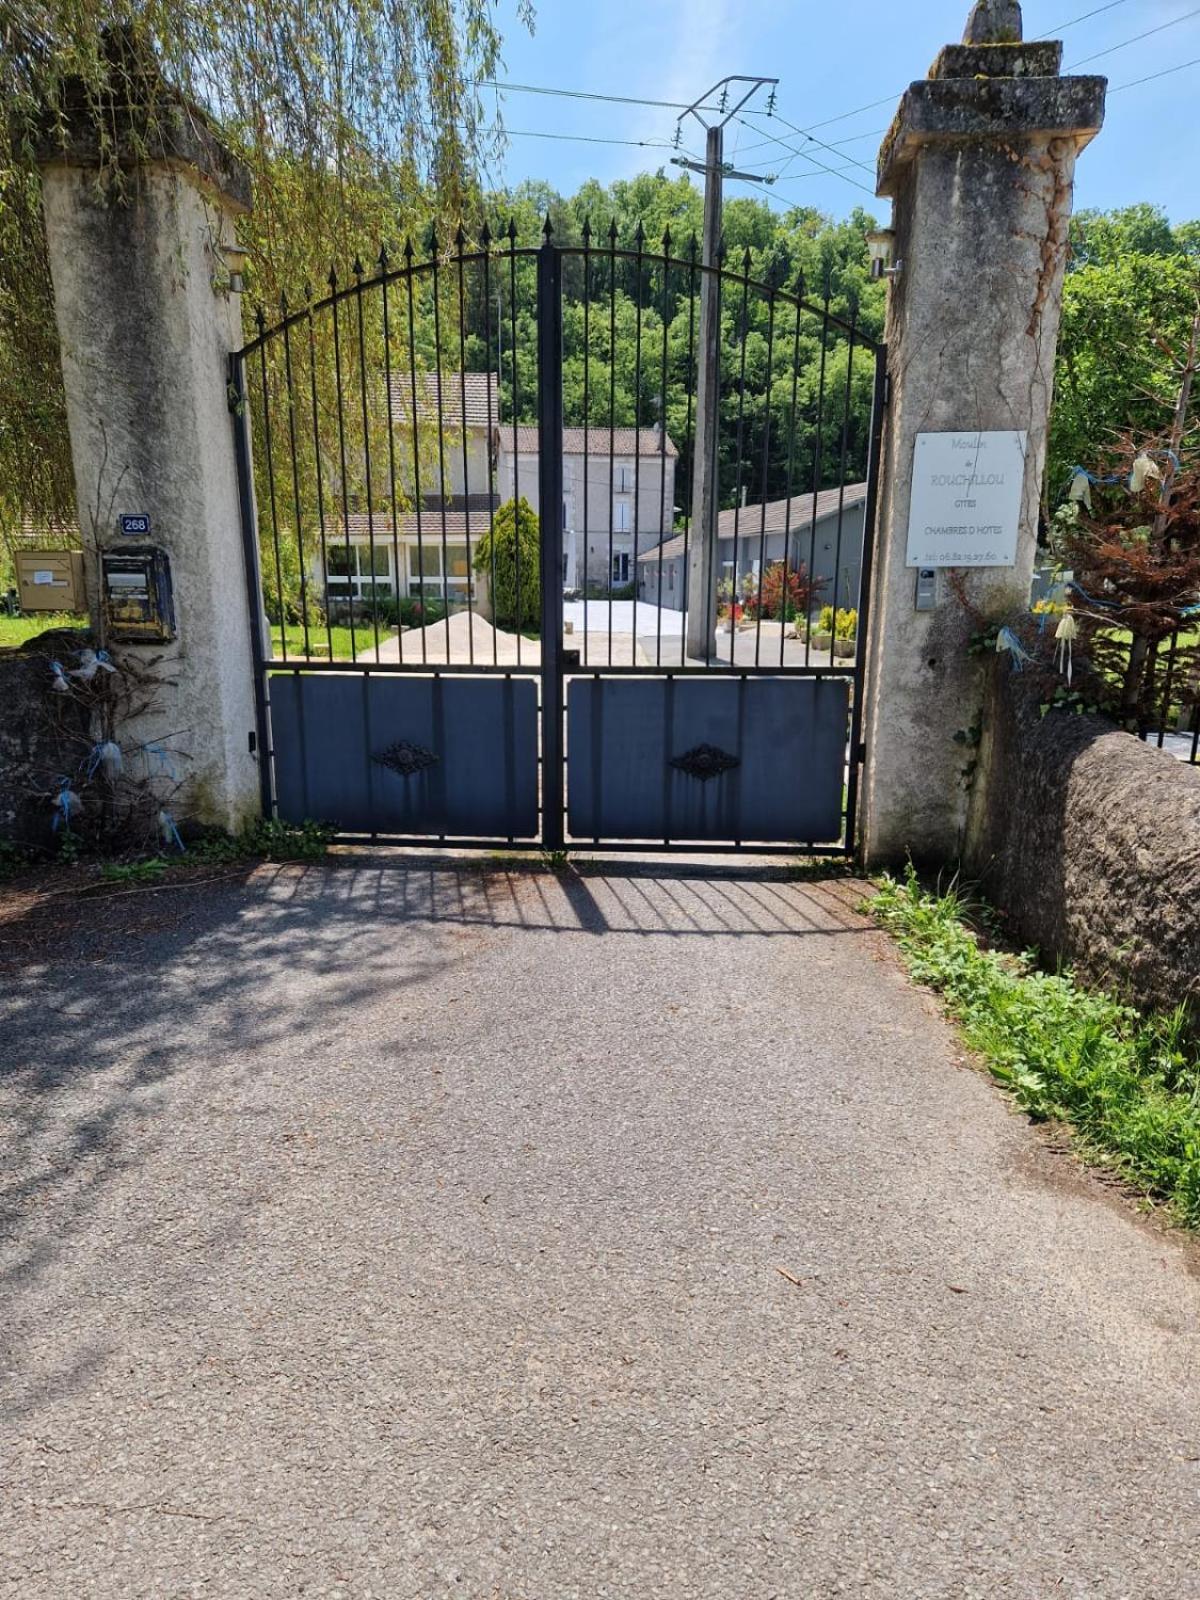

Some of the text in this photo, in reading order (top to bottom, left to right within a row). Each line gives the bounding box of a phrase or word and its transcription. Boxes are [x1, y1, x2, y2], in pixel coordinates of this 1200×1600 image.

[951, 438, 988, 449] Mouln
[125, 519, 146, 530] 268
[924, 526, 967, 535] CHAMBRES
